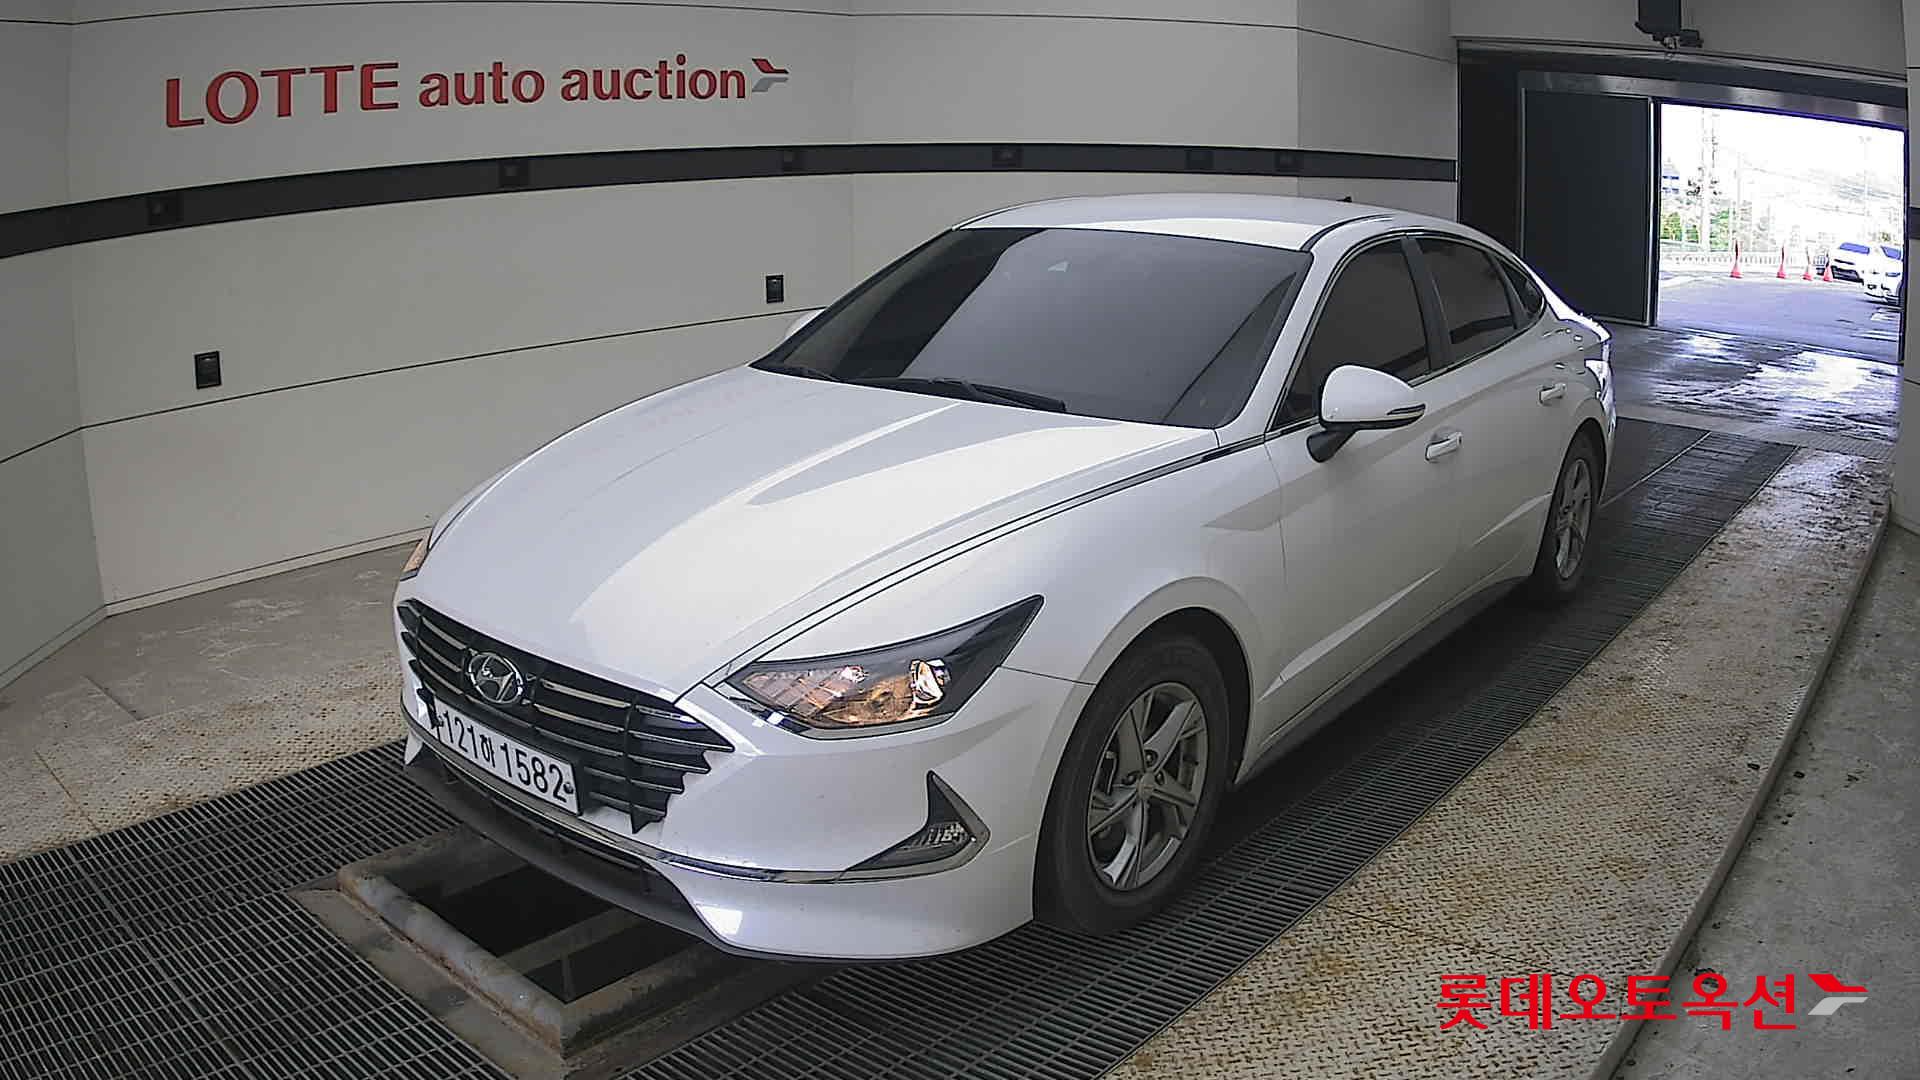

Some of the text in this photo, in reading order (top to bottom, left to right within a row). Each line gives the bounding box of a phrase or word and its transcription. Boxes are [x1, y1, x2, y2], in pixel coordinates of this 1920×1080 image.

[165, 55, 747, 127] LOTTE auto auction
[500, 742, 567, 803] 1582
